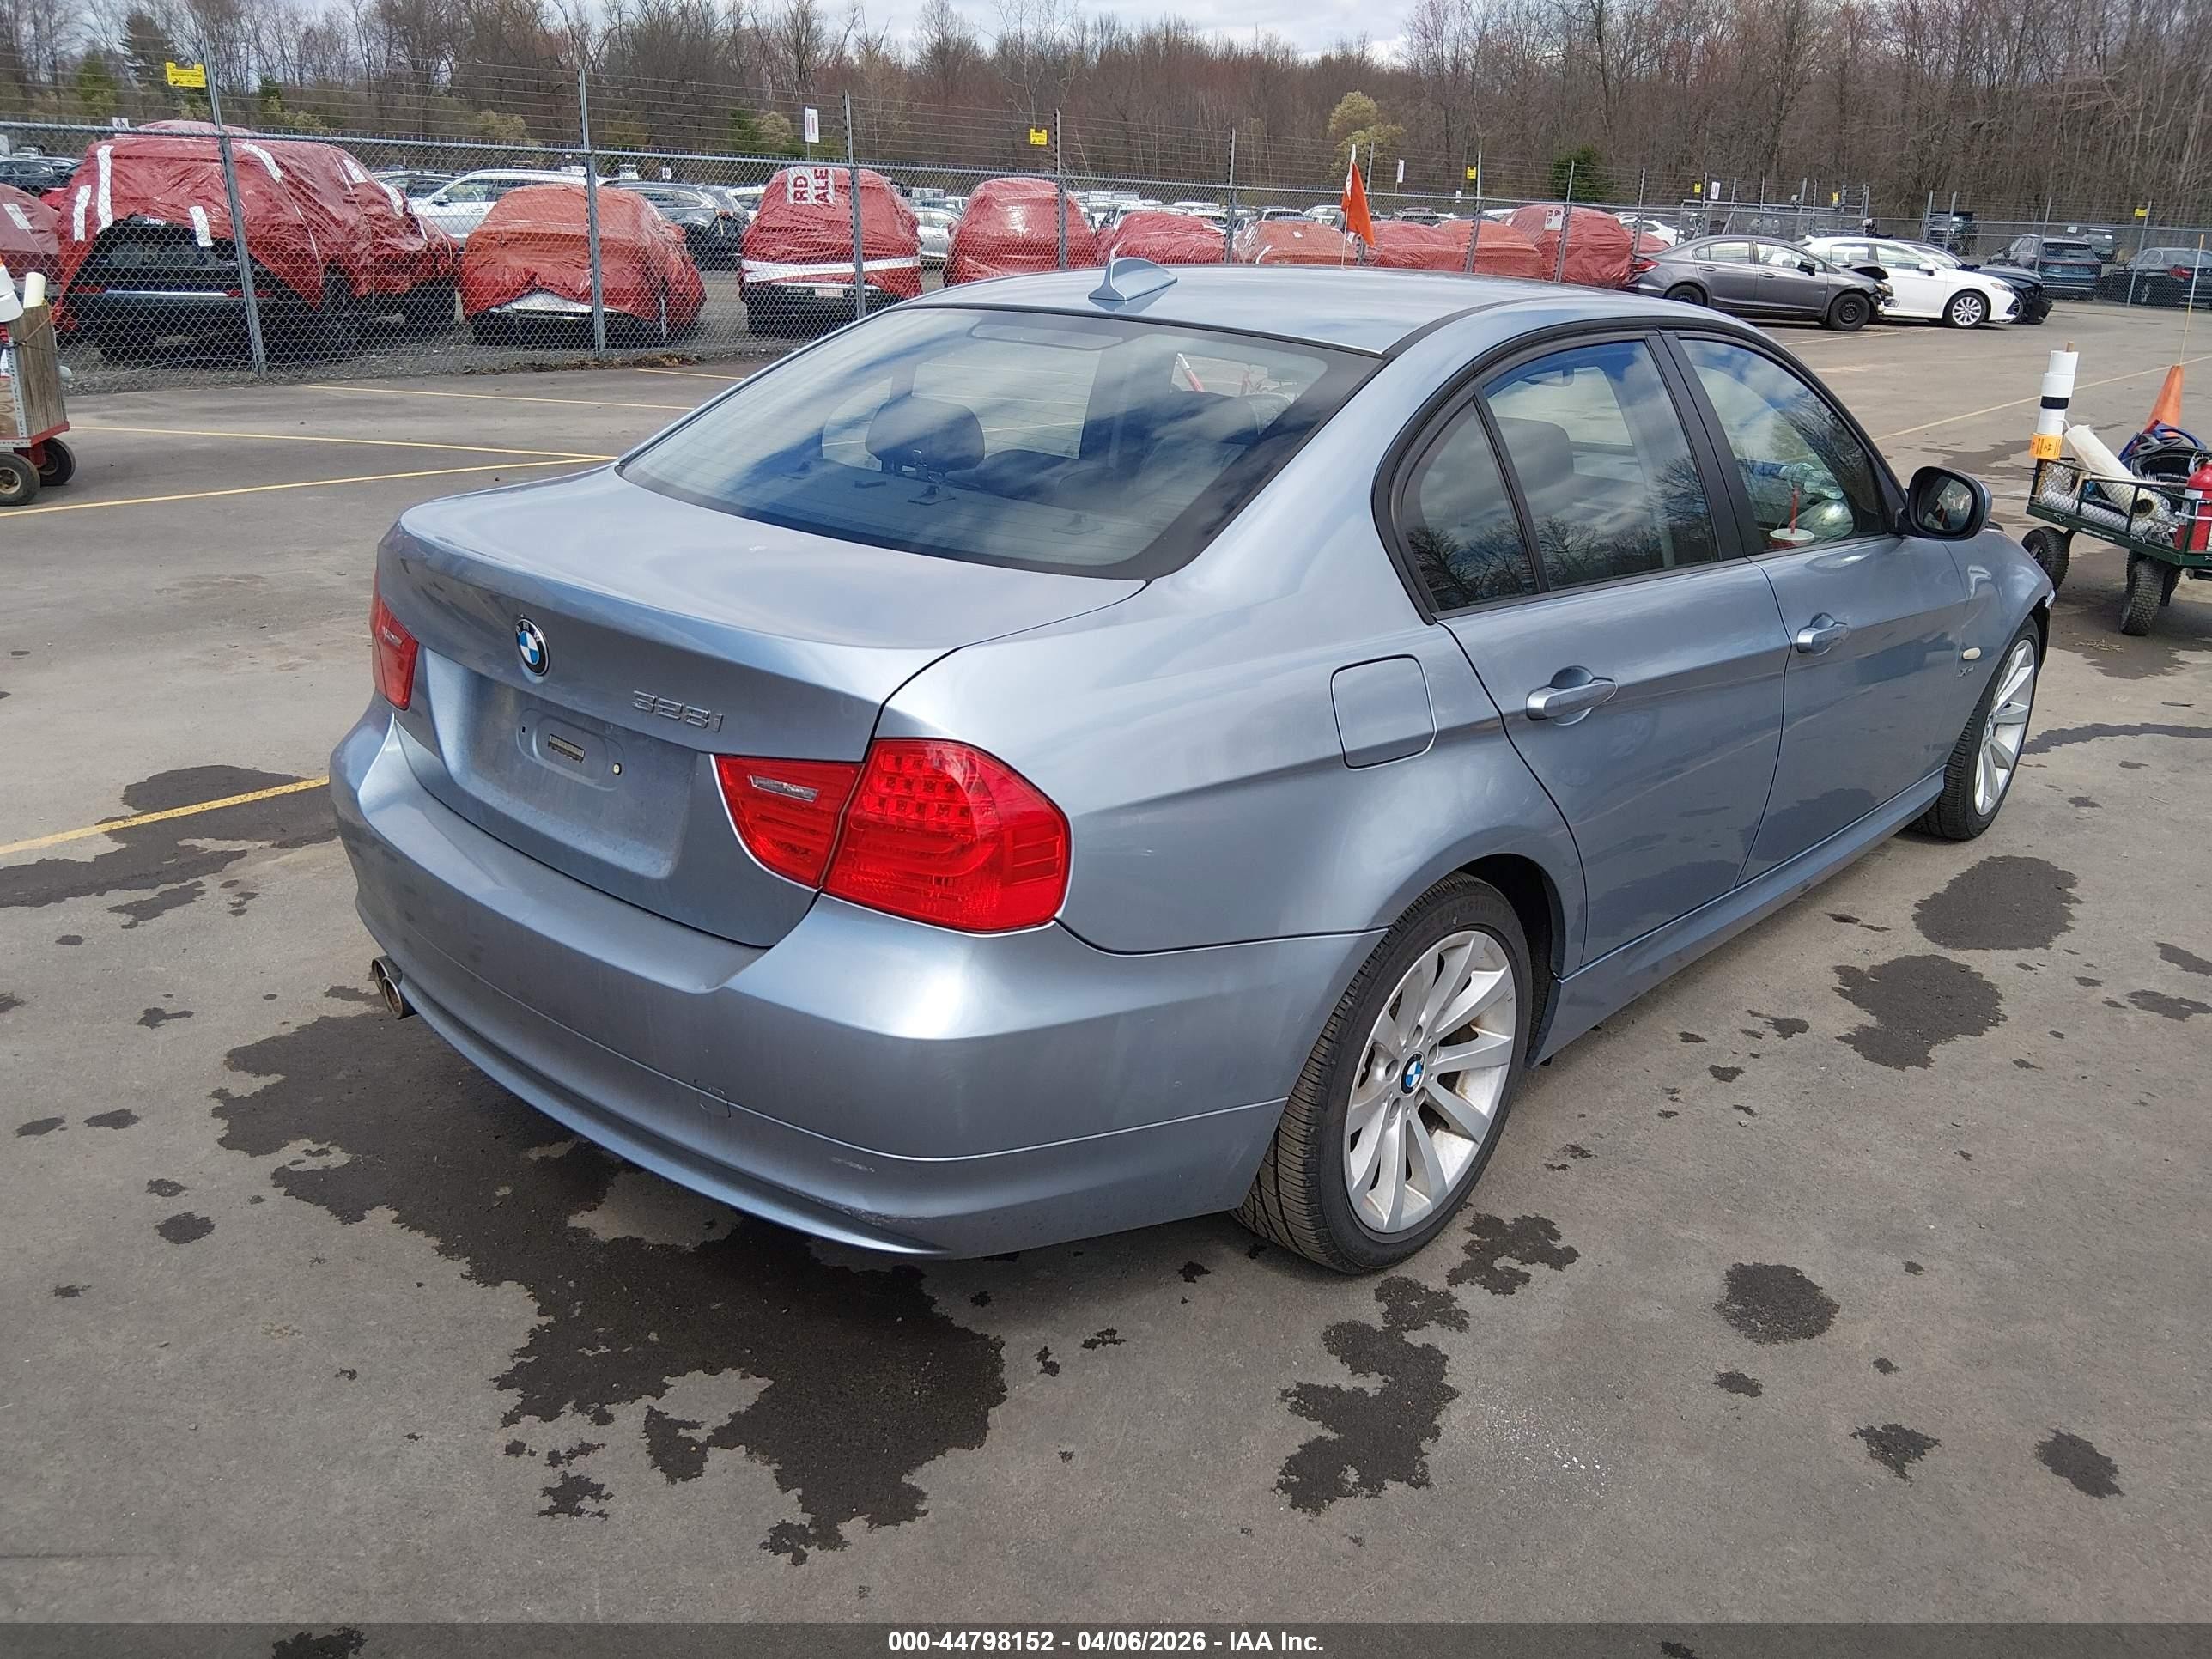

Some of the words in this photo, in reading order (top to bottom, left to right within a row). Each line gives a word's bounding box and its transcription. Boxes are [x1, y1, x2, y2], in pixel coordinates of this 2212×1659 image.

[793, 176, 808, 201] RD
[814, 168, 830, 203] ALE
[143, 216, 167, 226] Jeep
[632, 690, 724, 732] 328i
